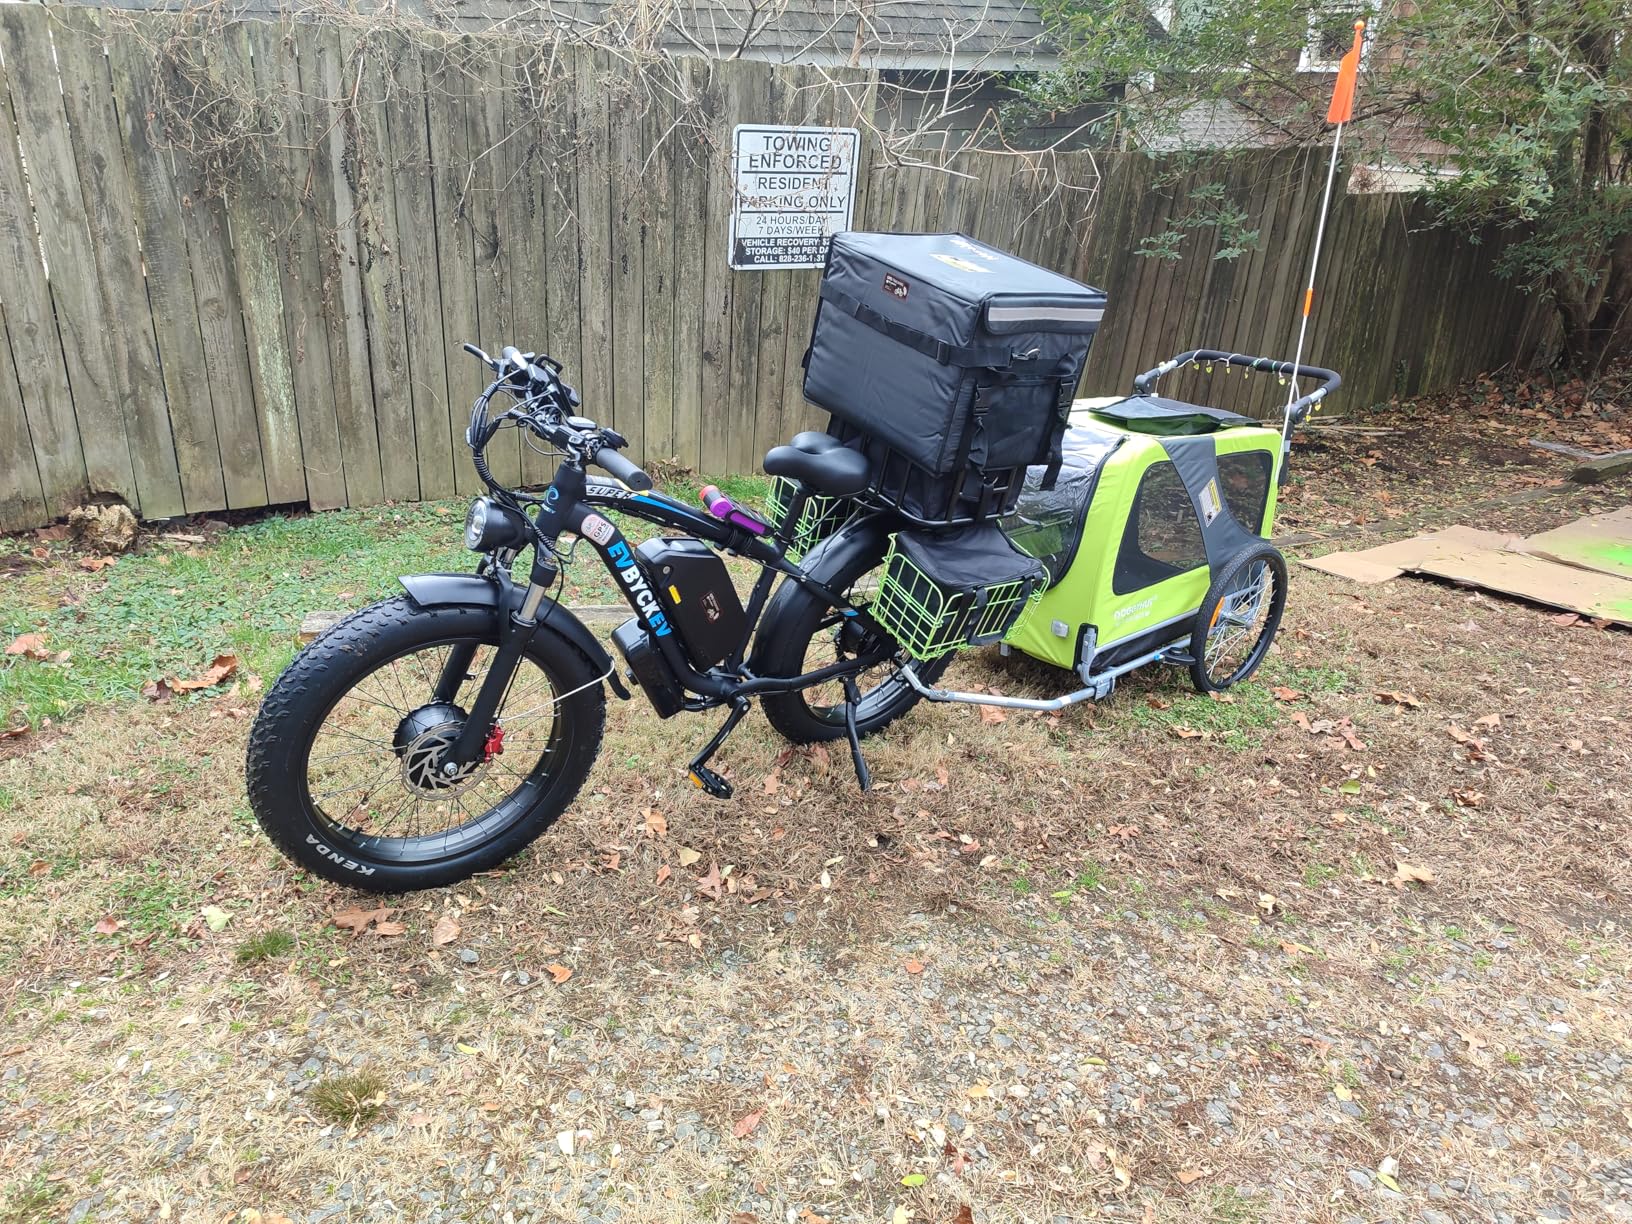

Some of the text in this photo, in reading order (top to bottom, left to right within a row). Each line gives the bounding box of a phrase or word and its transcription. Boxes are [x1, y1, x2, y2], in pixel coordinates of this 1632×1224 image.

[762, 136, 831, 152] TOWING
[749, 153, 842, 170] ENFORCED
[758, 176, 830, 191] RESIDENT
[808, 195, 846, 209] ONLY
[756, 216, 826, 225] 24 HOURS/DAY
[759, 226, 824, 236] 7 DAYS/WEEK
[741, 238, 776, 247] VEHICLE
[745, 246, 830, 256] STORAGE: $40 PER DA
[753, 254, 825, 264] CALL: 828-236-131
[587, 486, 632, 499] SUPER
[593, 521, 607, 538] GPS
[305, 833, 376, 876] KENDA
